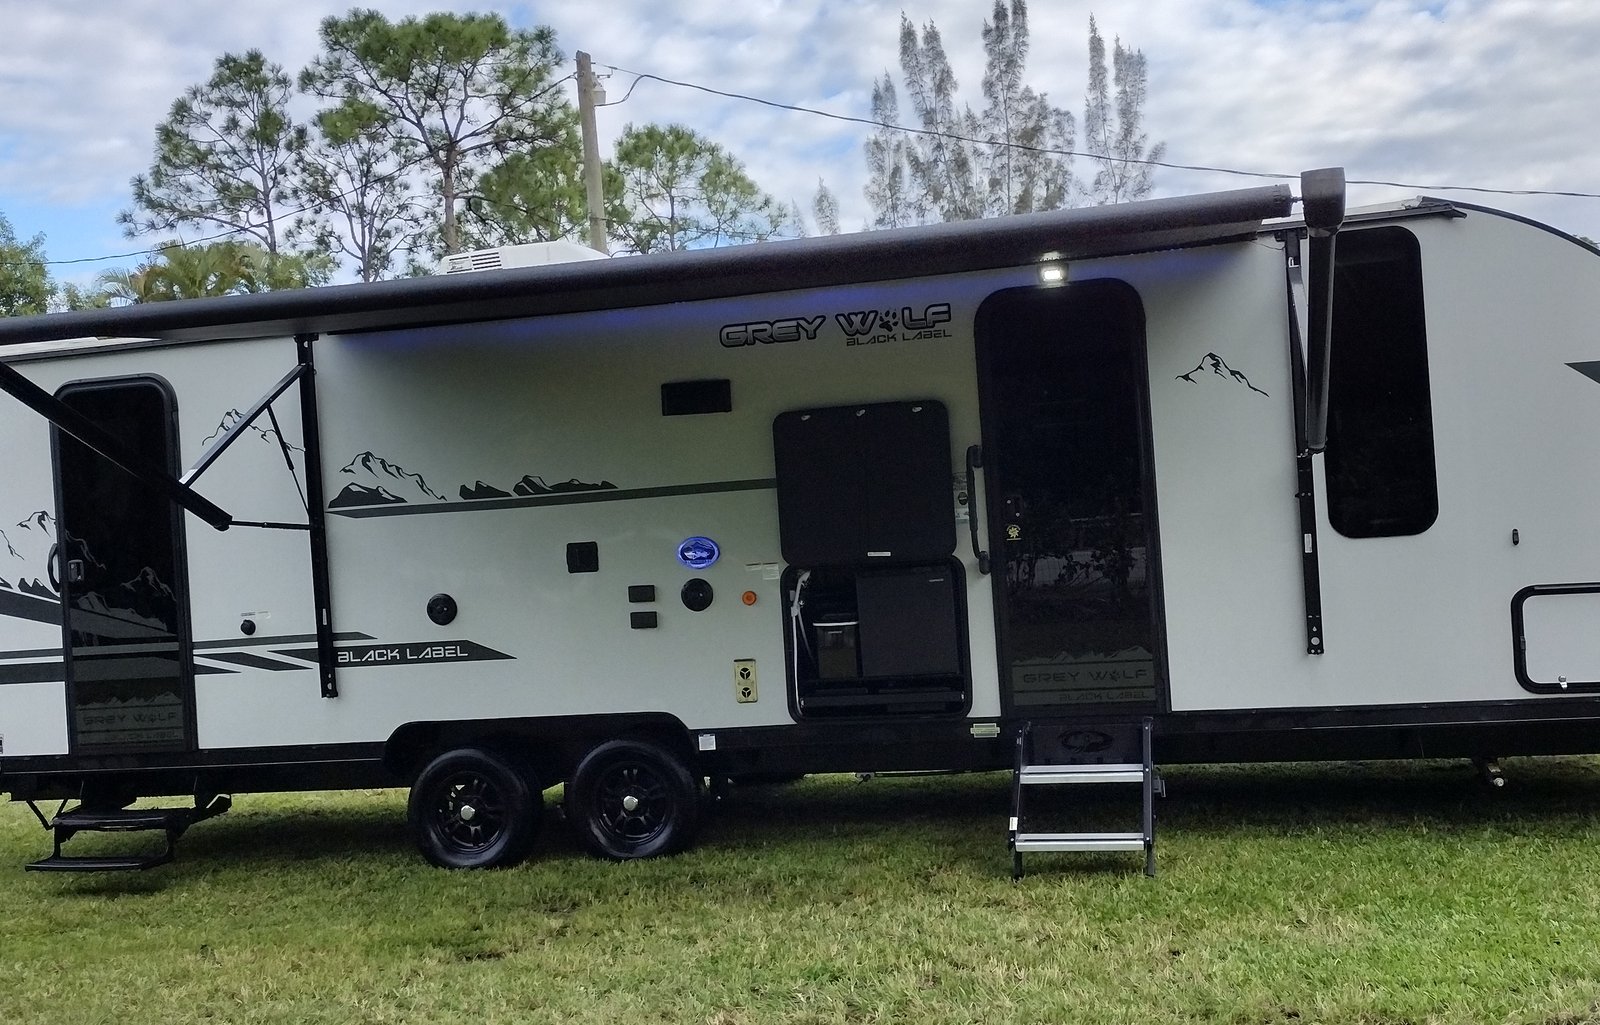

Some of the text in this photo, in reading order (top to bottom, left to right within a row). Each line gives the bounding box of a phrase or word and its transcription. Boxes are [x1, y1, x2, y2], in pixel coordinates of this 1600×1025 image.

[719, 314, 827, 348] GREY
[846, 329, 953, 347] BLACK LABEL
[337, 645, 469, 663] BLACK LABEL
[1023, 671, 1081, 684] GREY
